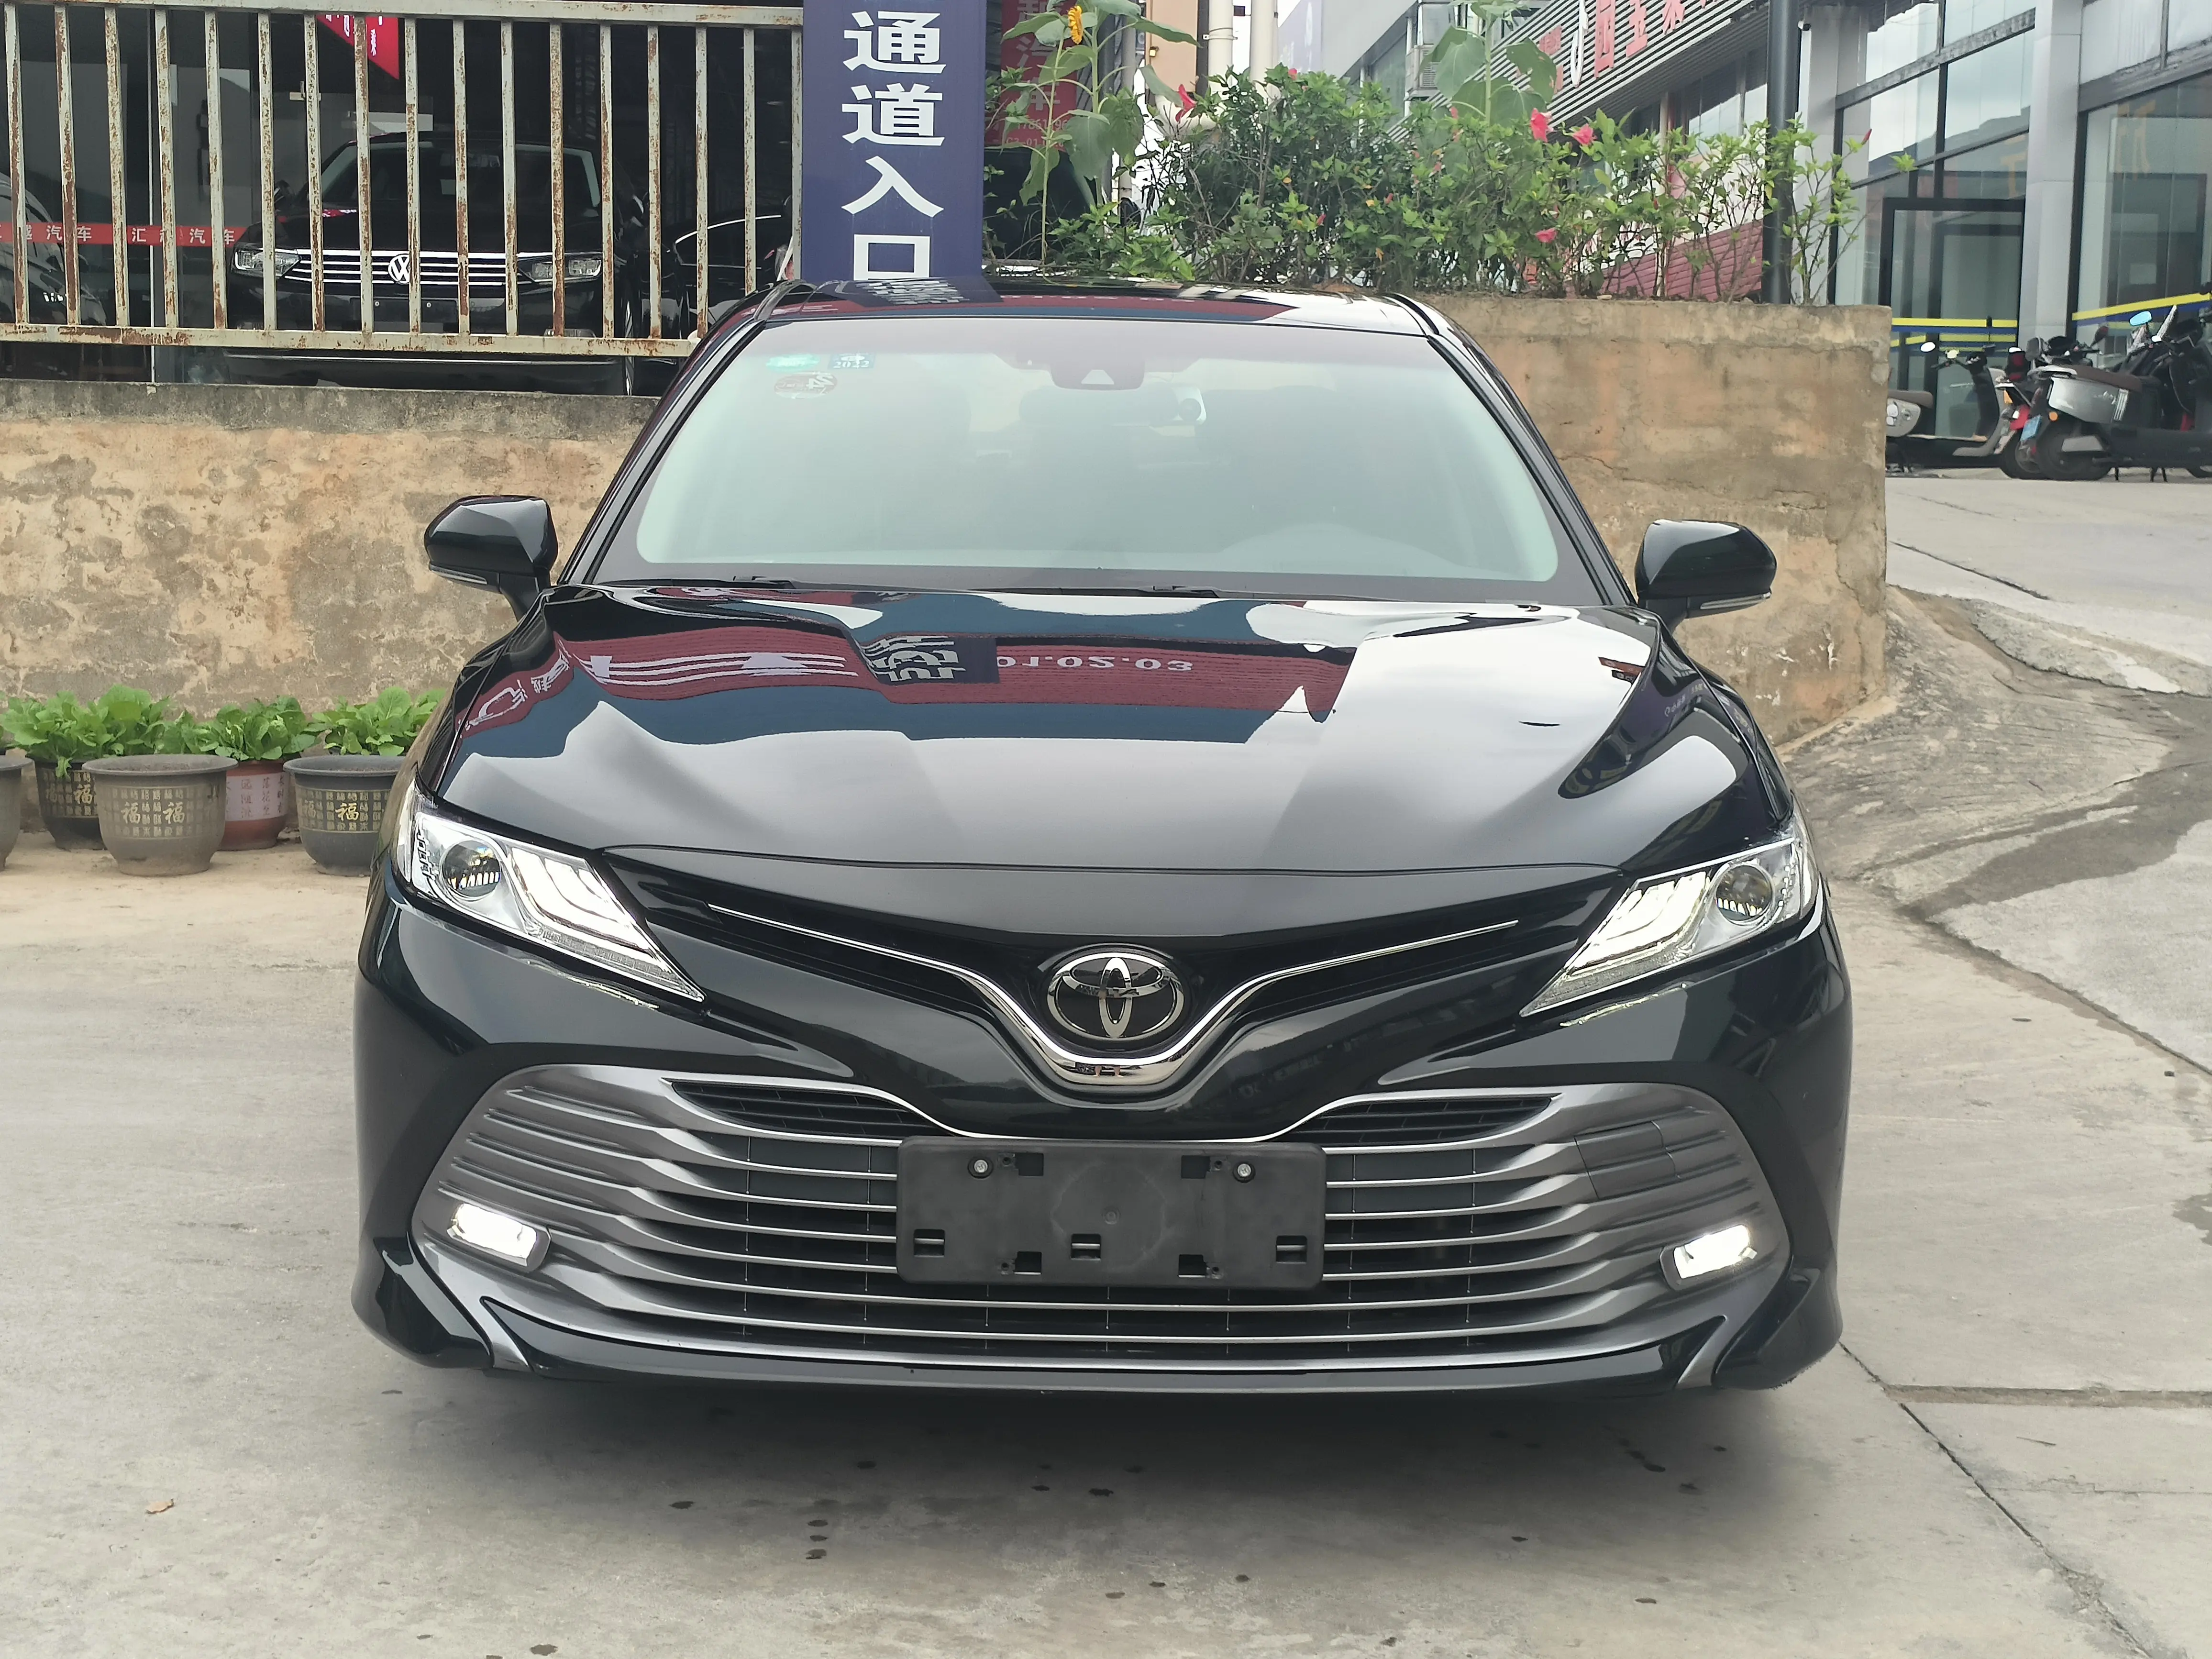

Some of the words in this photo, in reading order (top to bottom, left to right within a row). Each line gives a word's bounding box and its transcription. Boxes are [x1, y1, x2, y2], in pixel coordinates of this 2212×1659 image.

[841, 11, 947, 281] 通道入口
[132, 227, 235, 245] 汇汽车
[73, 783, 93, 804] 福
[121, 801, 141, 824] 福
[163, 801, 185, 824] 福
[335, 802, 359, 821] 福
